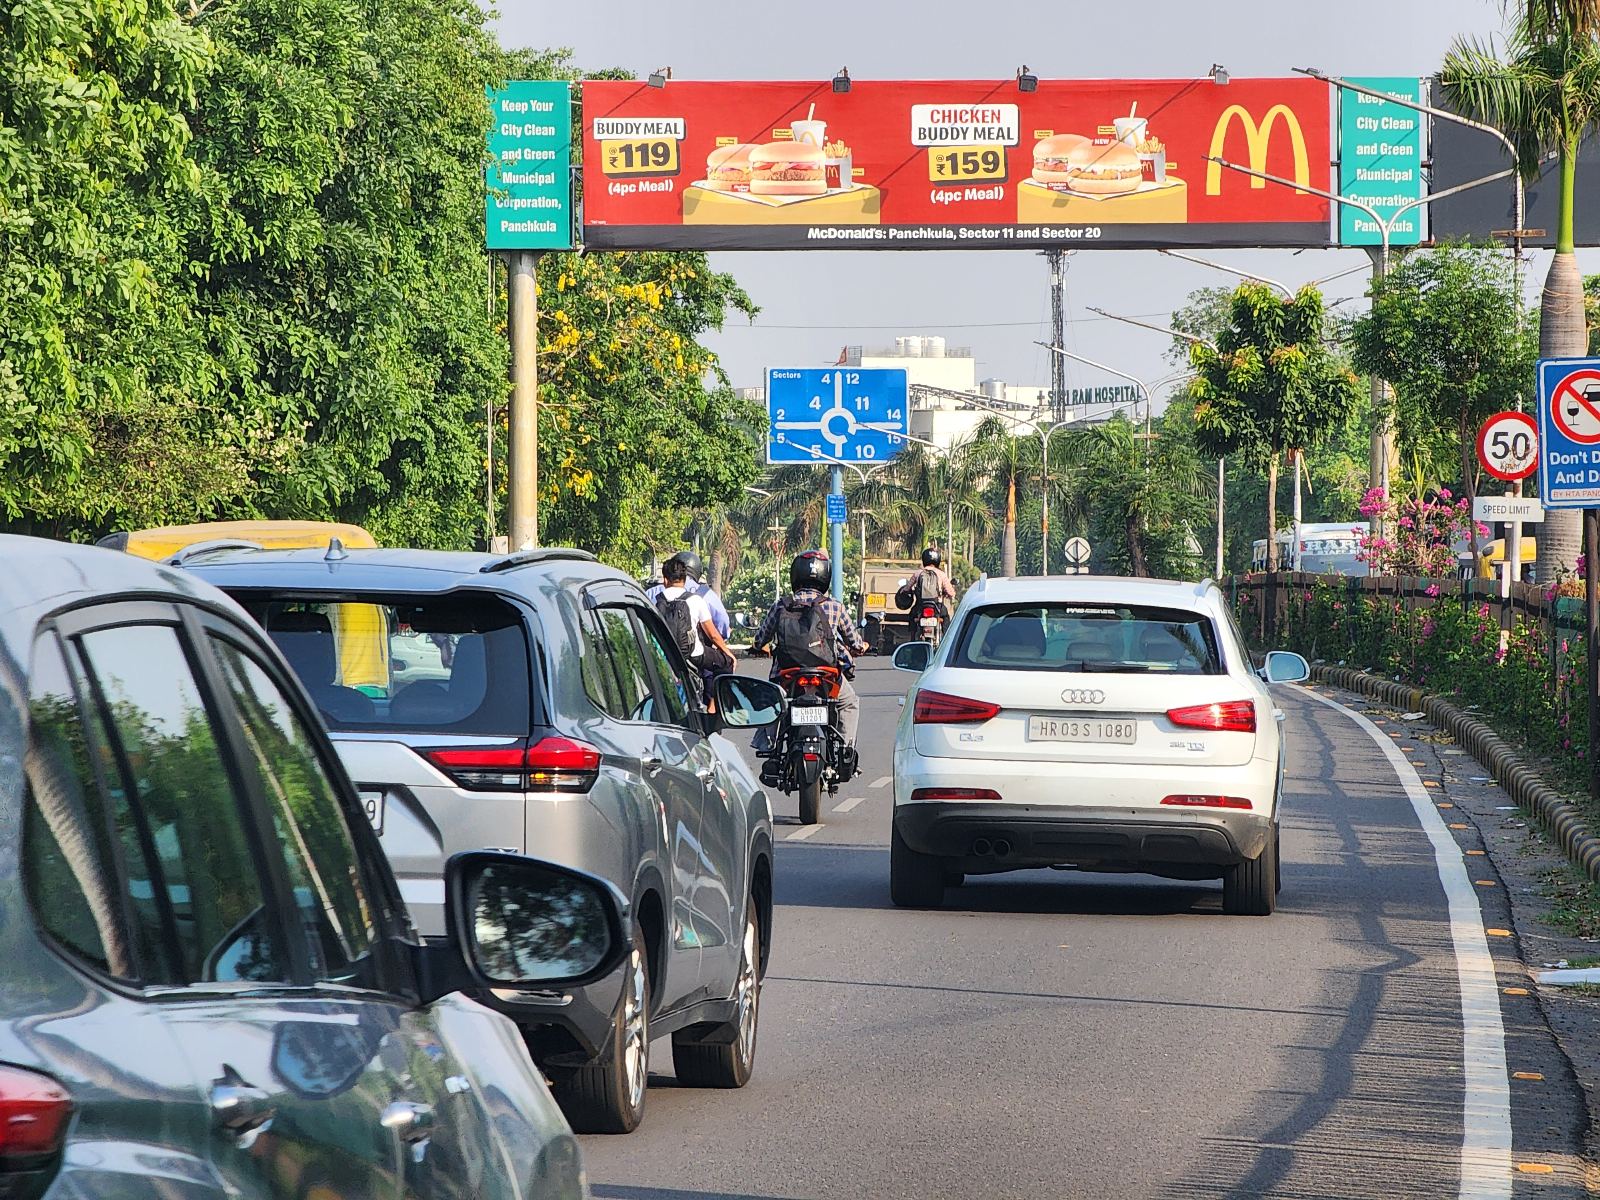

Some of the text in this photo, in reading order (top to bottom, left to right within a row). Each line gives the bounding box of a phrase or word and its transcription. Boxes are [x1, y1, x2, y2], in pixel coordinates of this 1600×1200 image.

[501, 99, 554, 114] Keep Your
[930, 109, 1001, 124] CHICKEN
[501, 123, 555, 138] City Clean
[597, 122, 680, 135] BUDDY MEAL
[1356, 117, 1414, 132] City Clean
[918, 126, 1015, 141] BUDDY MEAL
[501, 148, 556, 160] and Green
[1356, 142, 1413, 155] and Green
[502, 171, 555, 187] Municipal
[1356, 168, 1413, 183] Municipal
[608, 179, 674, 196] (4pc Meal)
[930, 186, 1004, 204] (4pc Meal)
[495, 195, 562, 210] Corporation,
[501, 220, 557, 232] Panchkula
[807, 227, 1101, 241] McDonald's: Panchkula, Sector 11 and Sector 20
[772, 371, 801, 379] Sectors
[821, 373, 831, 385] 4
[845, 373, 860, 385] 12
[1072, 388, 1092, 405] RAM
[1095, 385, 1142, 403] HOSPITAL
[809, 396, 821, 410] 4
[855, 396, 870, 410] 11
[776, 409, 785, 420] 2
[886, 409, 901, 420] 14
[776, 433, 785, 444] 5
[887, 433, 901, 444] 15
[1491, 431, 1531, 460] 50
[811, 445, 822, 458] 5
[855, 445, 875, 458] 10
[1549, 451, 1588, 465] Don't
[1555, 470, 1585, 484] And
[1483, 504, 1530, 515] SPEED LIMIT
